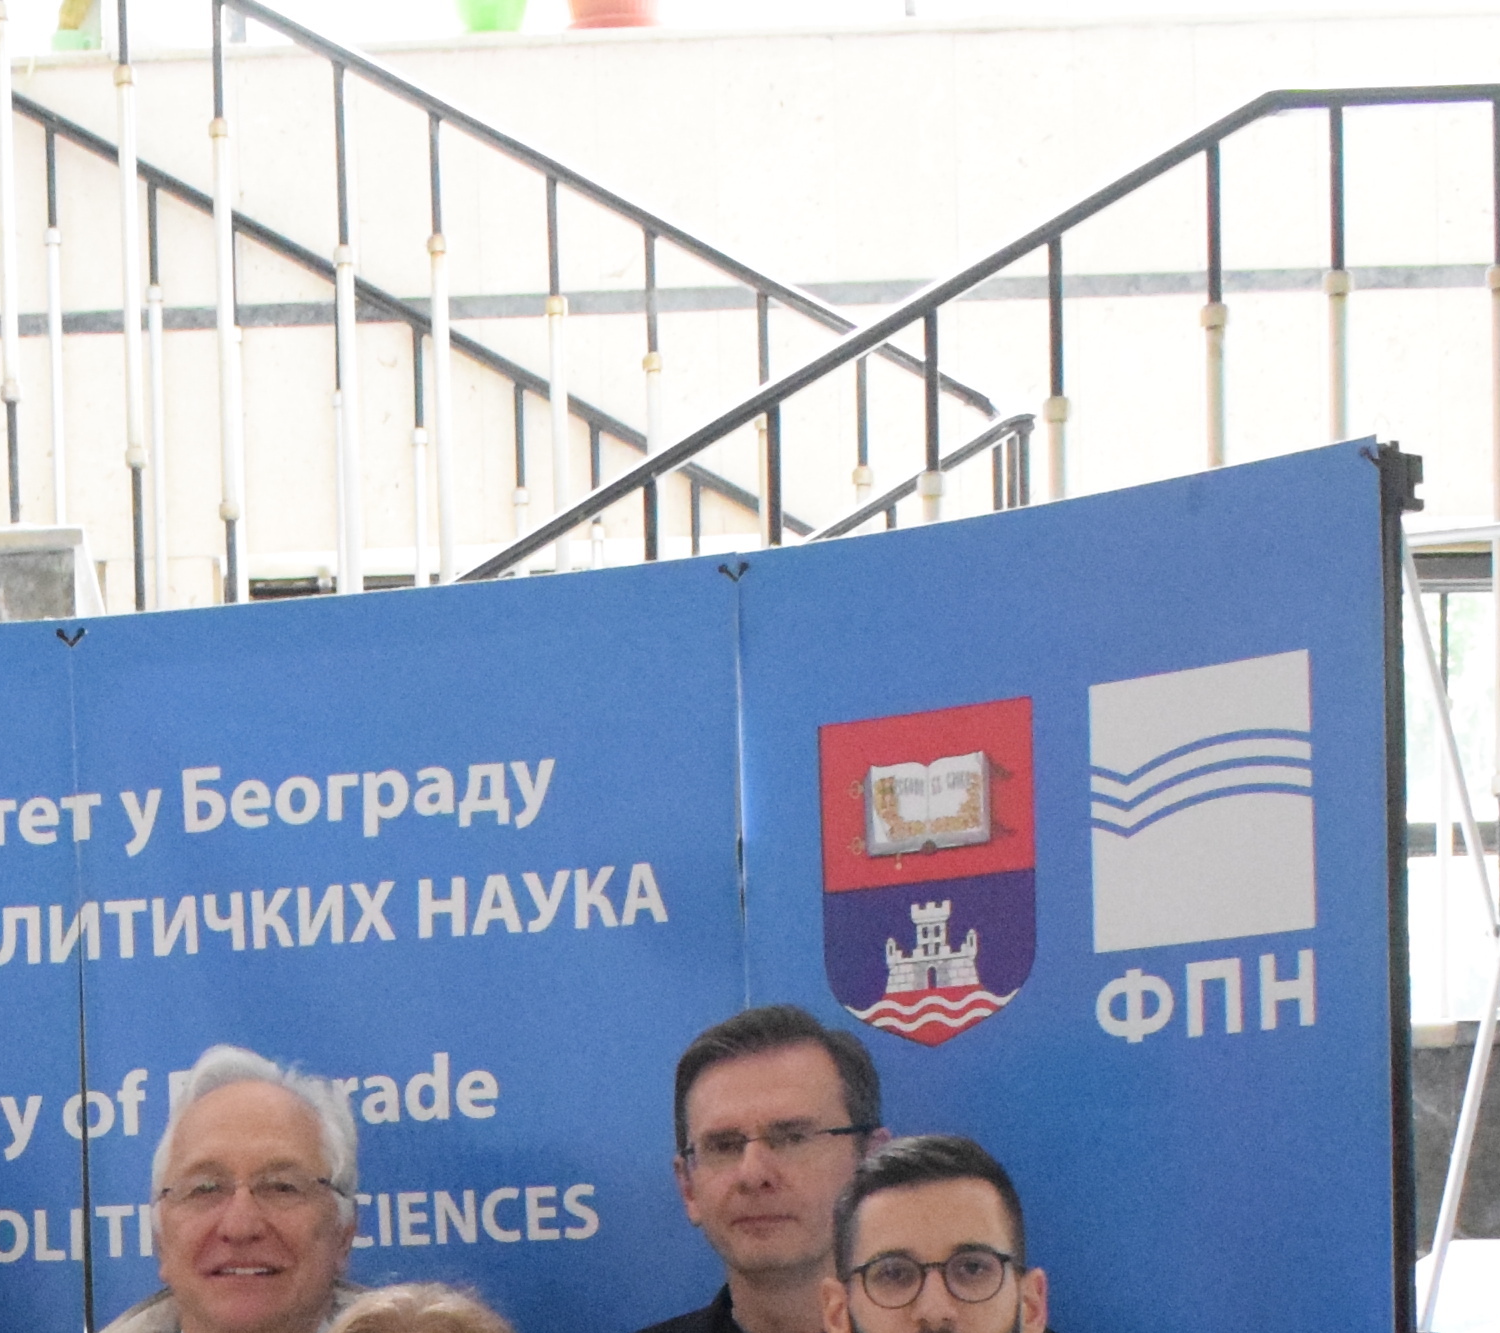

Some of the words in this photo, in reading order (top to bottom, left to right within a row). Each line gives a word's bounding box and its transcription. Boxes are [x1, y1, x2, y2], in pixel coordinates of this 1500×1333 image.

[120, 788, 162, 857] у
[181, 757, 556, 838] Београду
[418, 861, 670, 940] НАУКА
[1095, 948, 1316, 1044] ФПН
[62, 1068, 149, 1139] of
[348, 1183, 600, 1249] CIENCES
